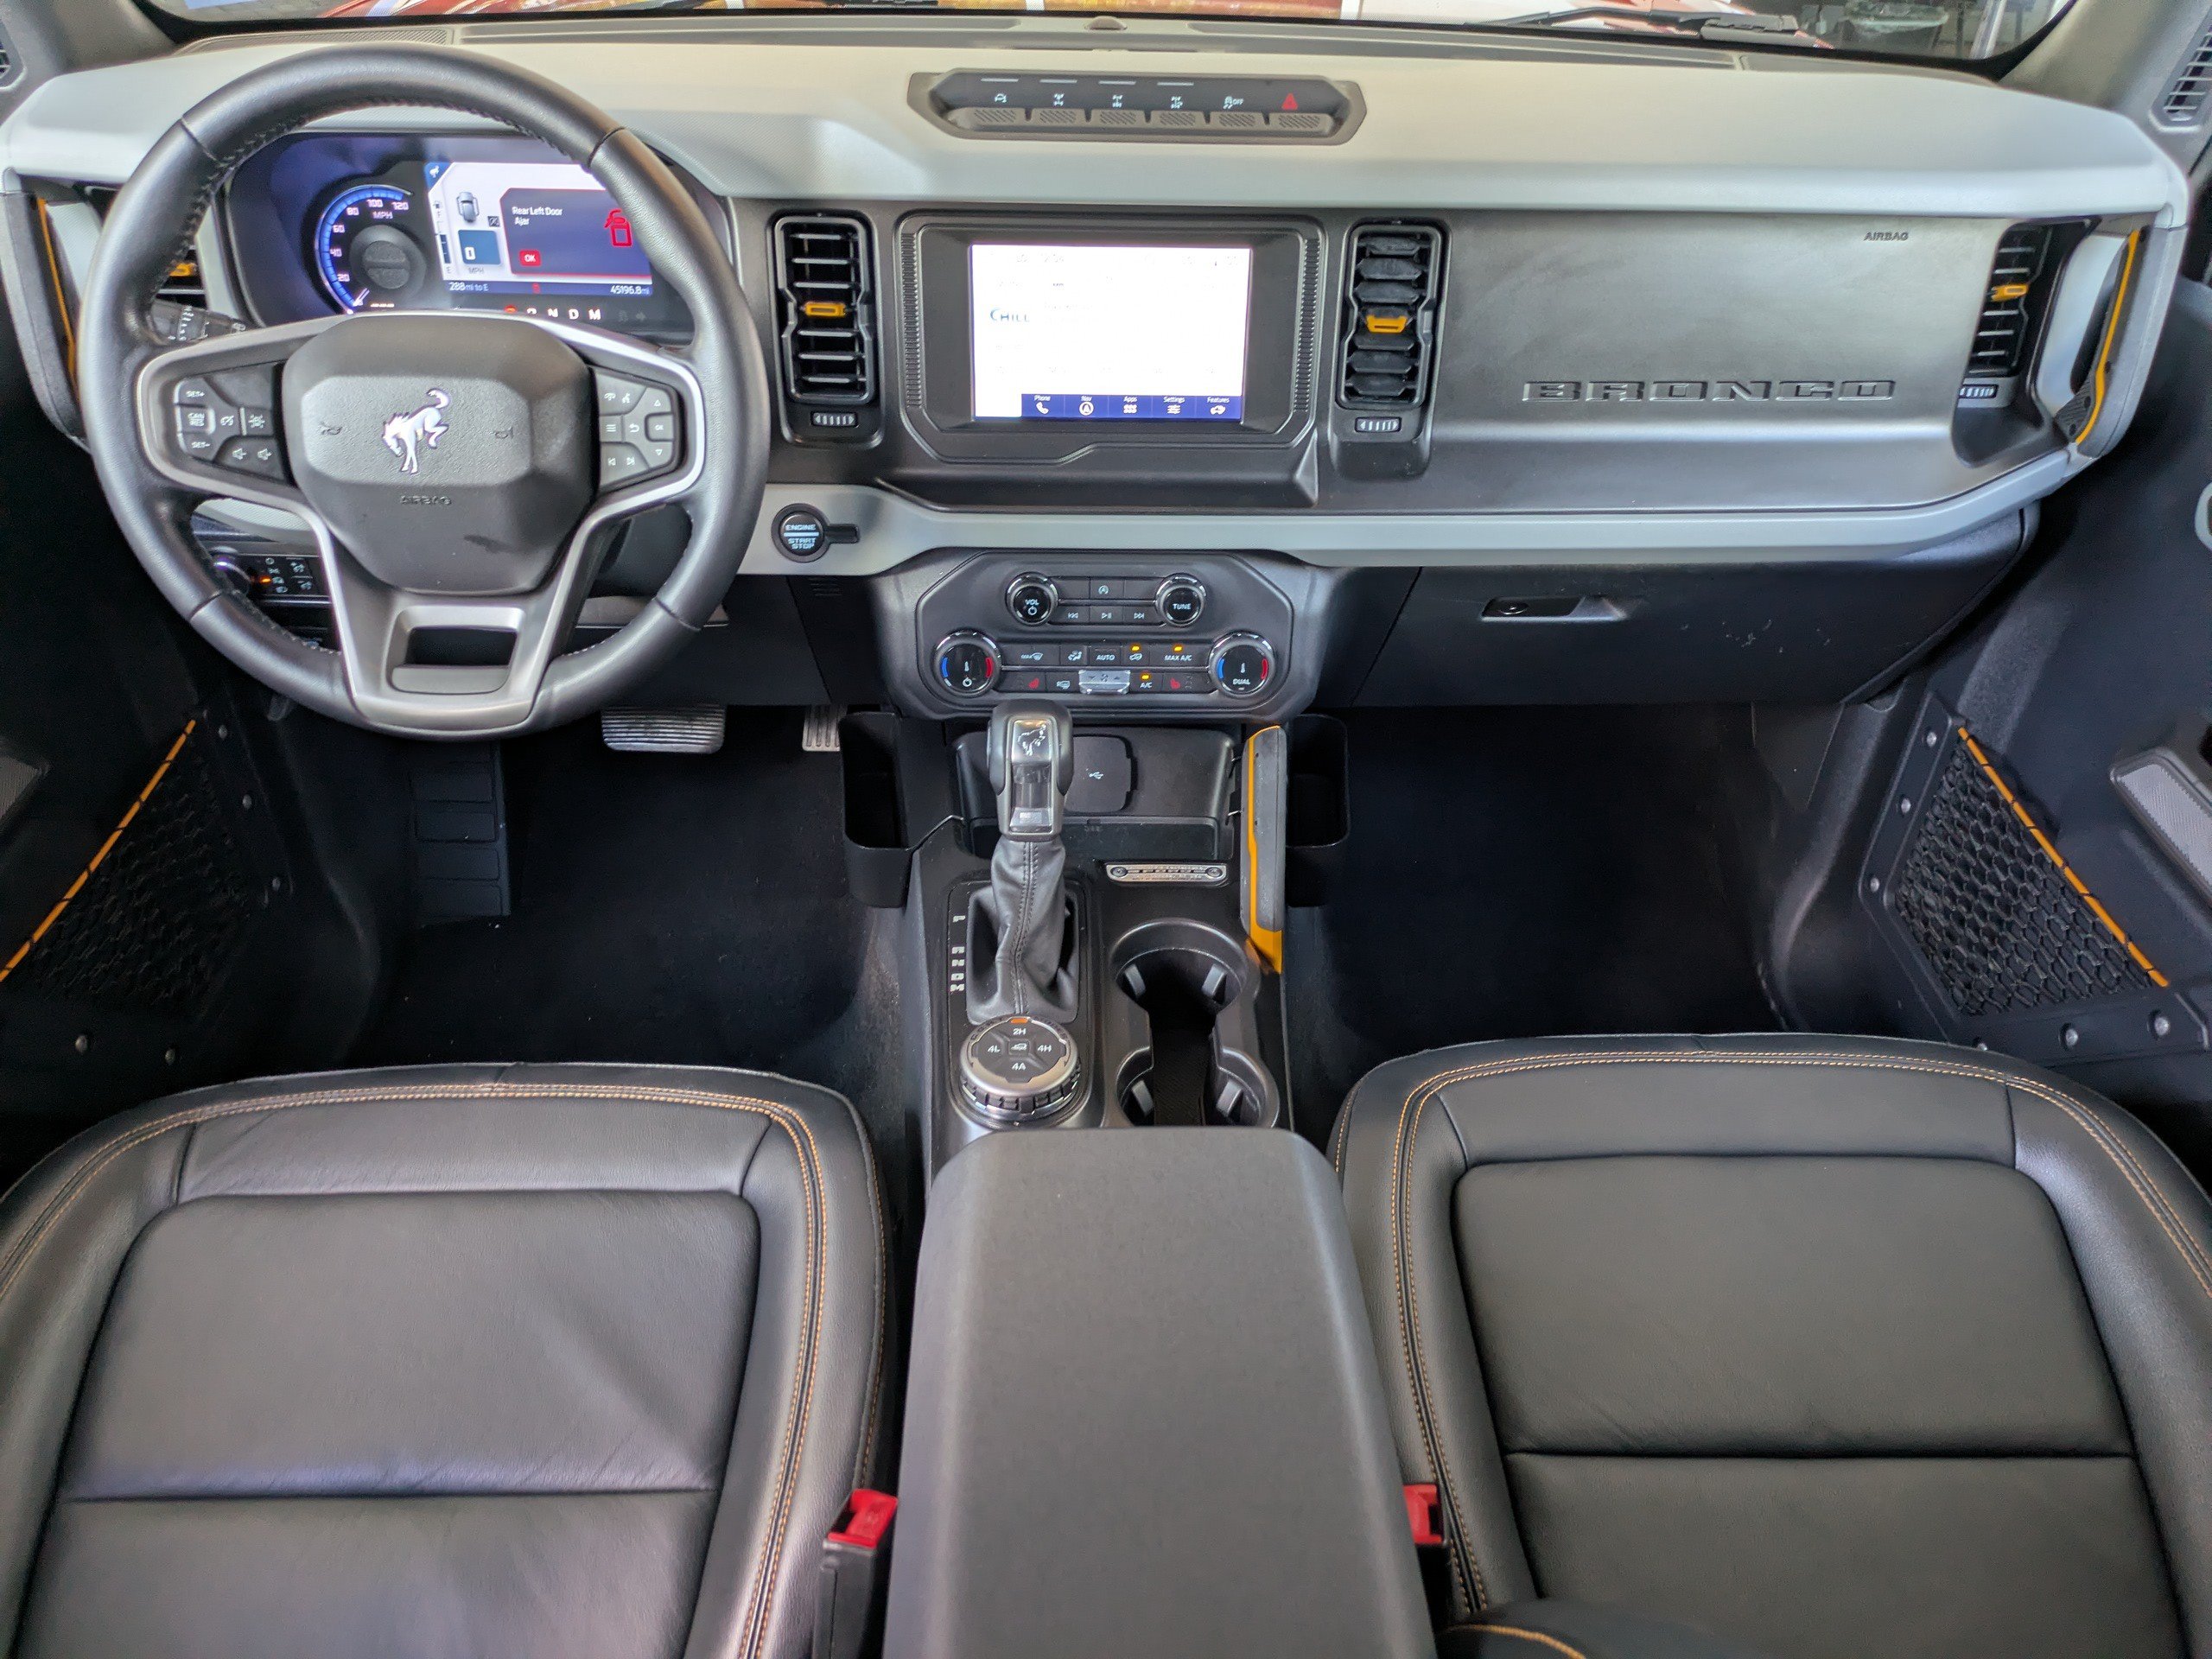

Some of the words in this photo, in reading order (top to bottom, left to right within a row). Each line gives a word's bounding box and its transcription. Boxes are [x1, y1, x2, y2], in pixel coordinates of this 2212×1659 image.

[366, 199, 383, 207] 100
[391, 202, 409, 211] 120
[346, 207, 359, 216] 80
[372, 211, 393, 219] MPH
[512, 207, 529, 215] Rear
[530, 207, 544, 215] Left
[545, 207, 563, 215] Door
[515, 217, 530, 226] Ajar
[1864, 232, 1910, 242] AIRBAG
[329, 249, 342, 257] 40
[524, 254, 536, 263] OK
[547, 308, 558, 318] N
[569, 308, 580, 320] D
[588, 308, 601, 321] M
[1522, 380, 1897, 403] BRONCO
[400, 495, 452, 505] AIRBAG
[1025, 598, 1039, 607] VOL
[1173, 602, 1192, 611] TUNE
[950, 983, 965, 992] M
[987, 1045, 1001, 1053] 4L
